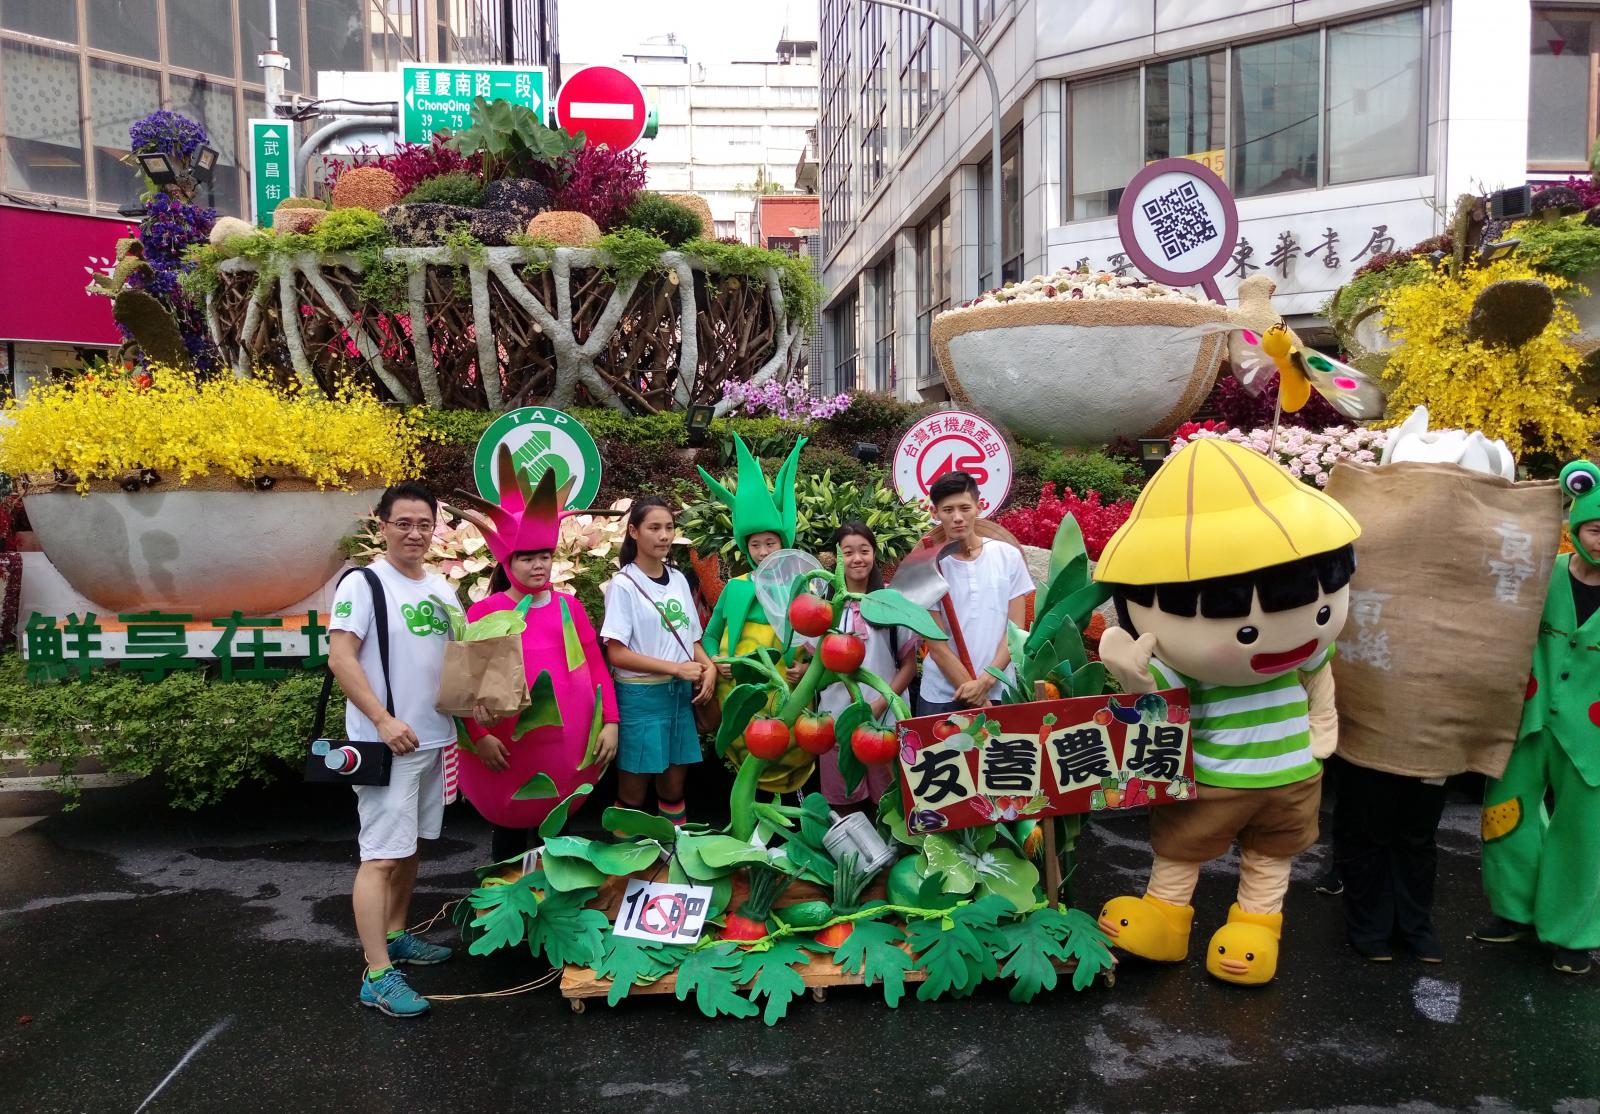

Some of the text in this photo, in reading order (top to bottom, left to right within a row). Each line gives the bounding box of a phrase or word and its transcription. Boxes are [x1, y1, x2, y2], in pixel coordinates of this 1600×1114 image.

[415, 71, 531, 98] 重慶南路一段
[417, 99, 470, 115] ChongQing
[421, 114, 433, 127] 39
[451, 115, 463, 128] 75
[1225, 225, 1396, 279] 東華書局
[509, 410, 568, 424] TAP
[903, 416, 1001, 458] 台灣有機農產品
[910, 724, 1184, 803] 友善農場
[624, 888, 705, 938] 化肥
